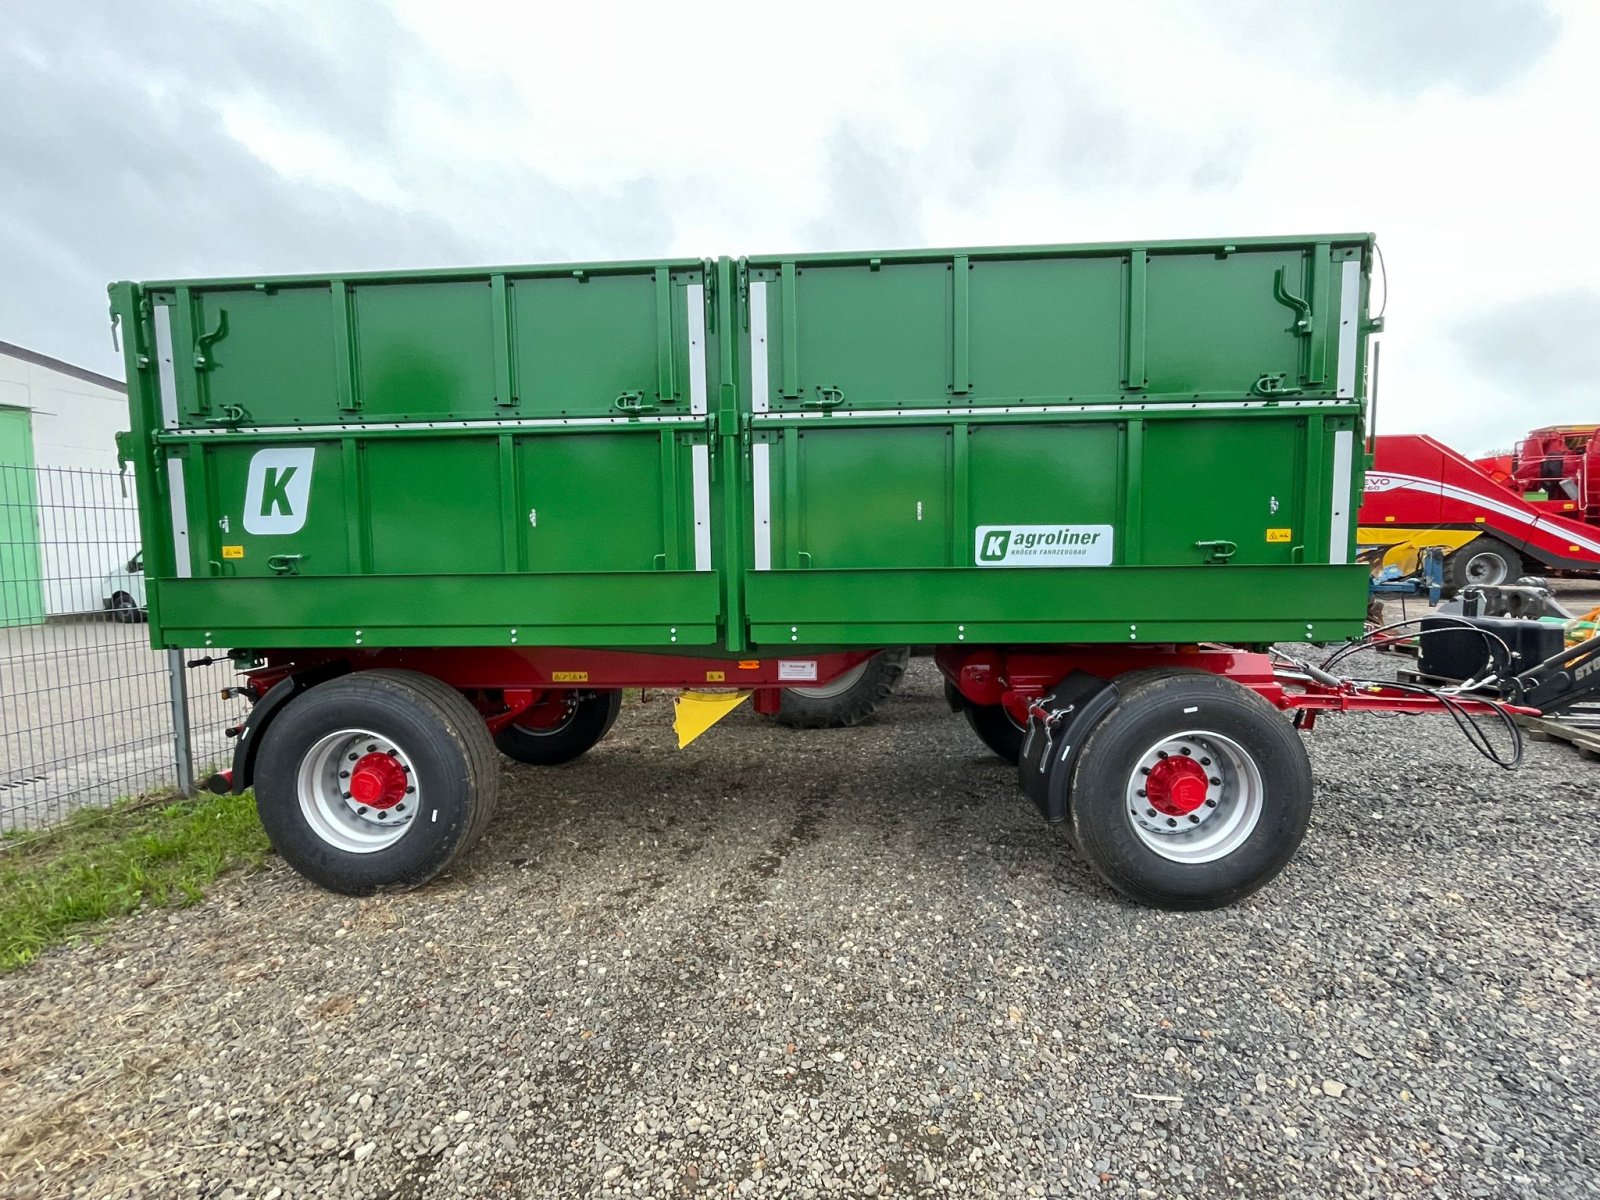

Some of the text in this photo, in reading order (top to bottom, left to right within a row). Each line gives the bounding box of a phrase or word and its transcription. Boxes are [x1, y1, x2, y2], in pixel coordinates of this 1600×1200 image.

[260, 467, 298, 516] K
[987, 536, 1005, 556] K
[1013, 529, 1100, 548] agroliner
